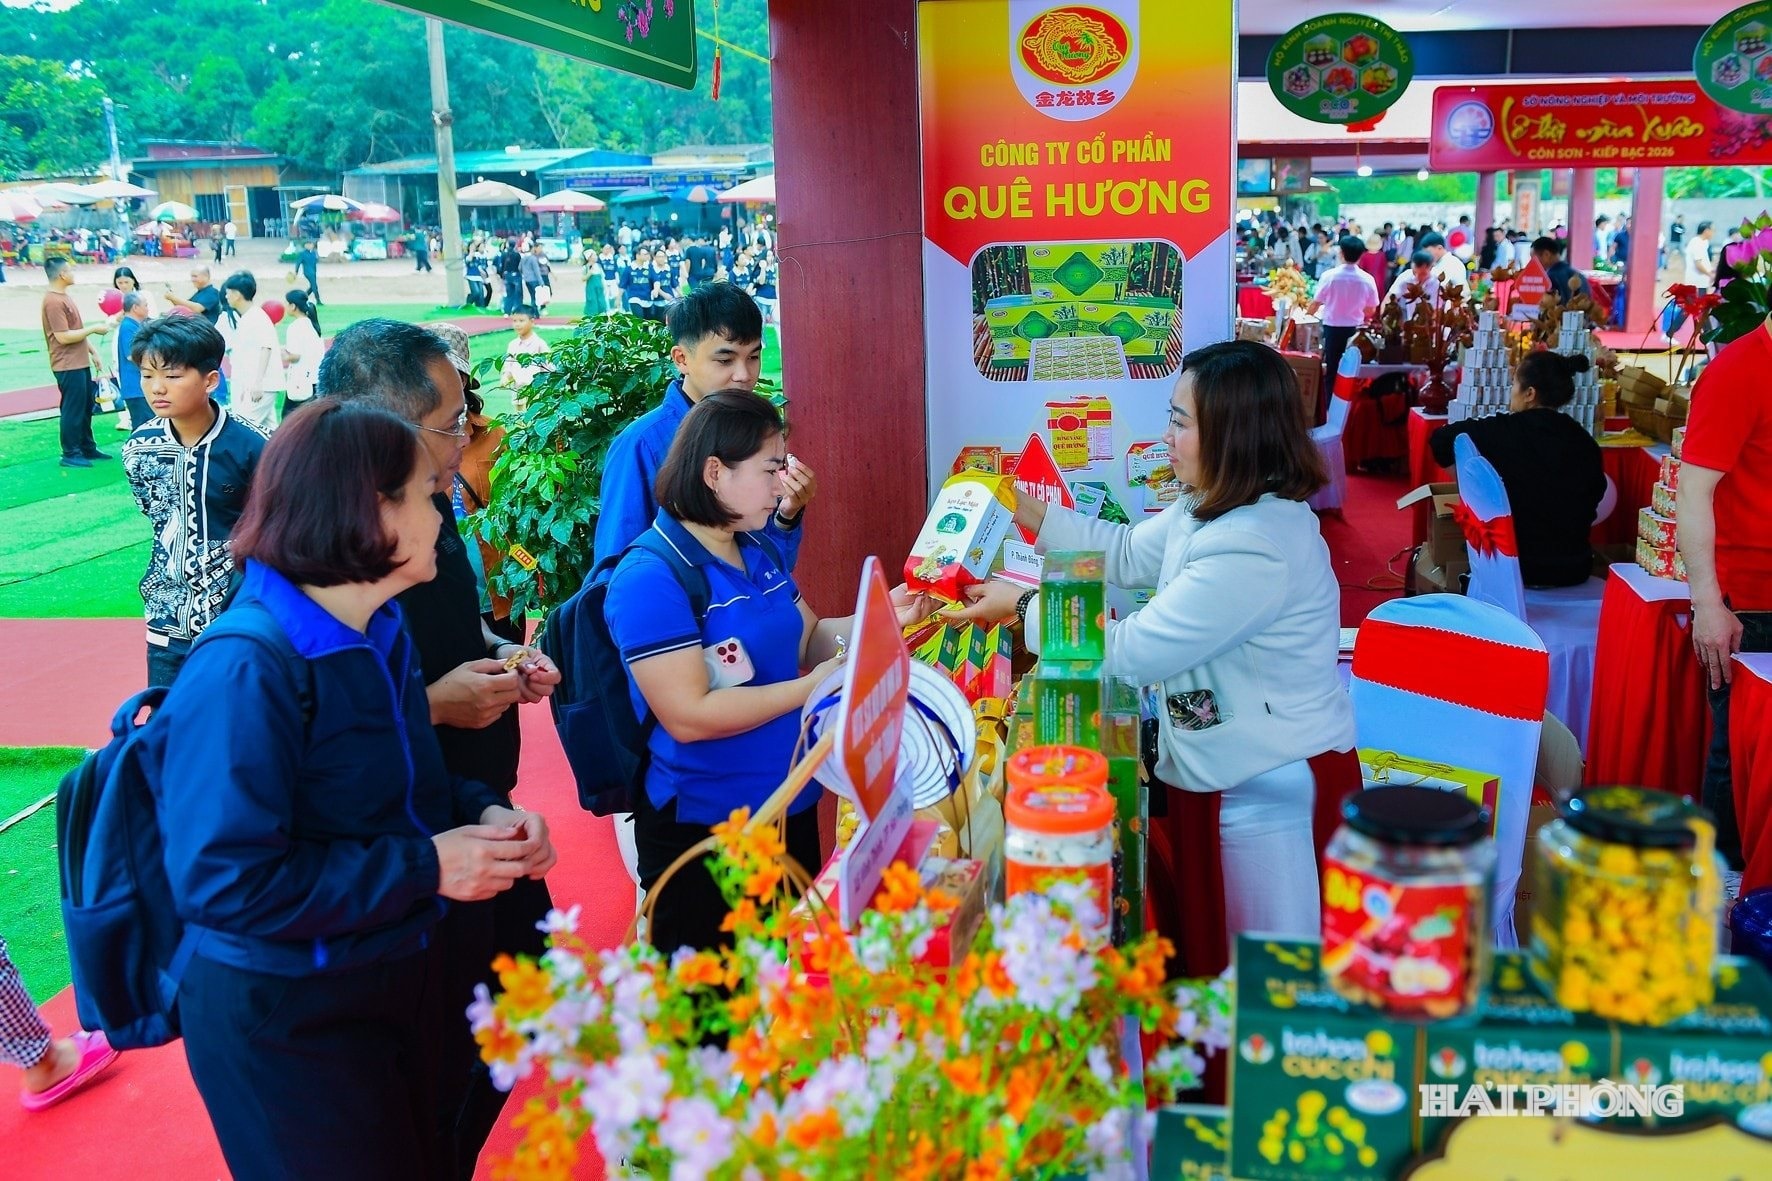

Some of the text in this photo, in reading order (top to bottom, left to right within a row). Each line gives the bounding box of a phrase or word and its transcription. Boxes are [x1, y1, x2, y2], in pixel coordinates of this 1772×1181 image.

[1035, 89, 1116, 108] 金龙故乡
[980, 131, 1172, 167] CÔNG TY CỔ PHẦN
[1528, 146, 1555, 159] CÔN
[1557, 147, 1584, 158] SƠN
[1592, 144, 1619, 158] KIẾP
[1621, 146, 1645, 160] BẠC
[1647, 146, 1675, 158] 2026
[943, 176, 1211, 220] QUÊ HƯƠNG
